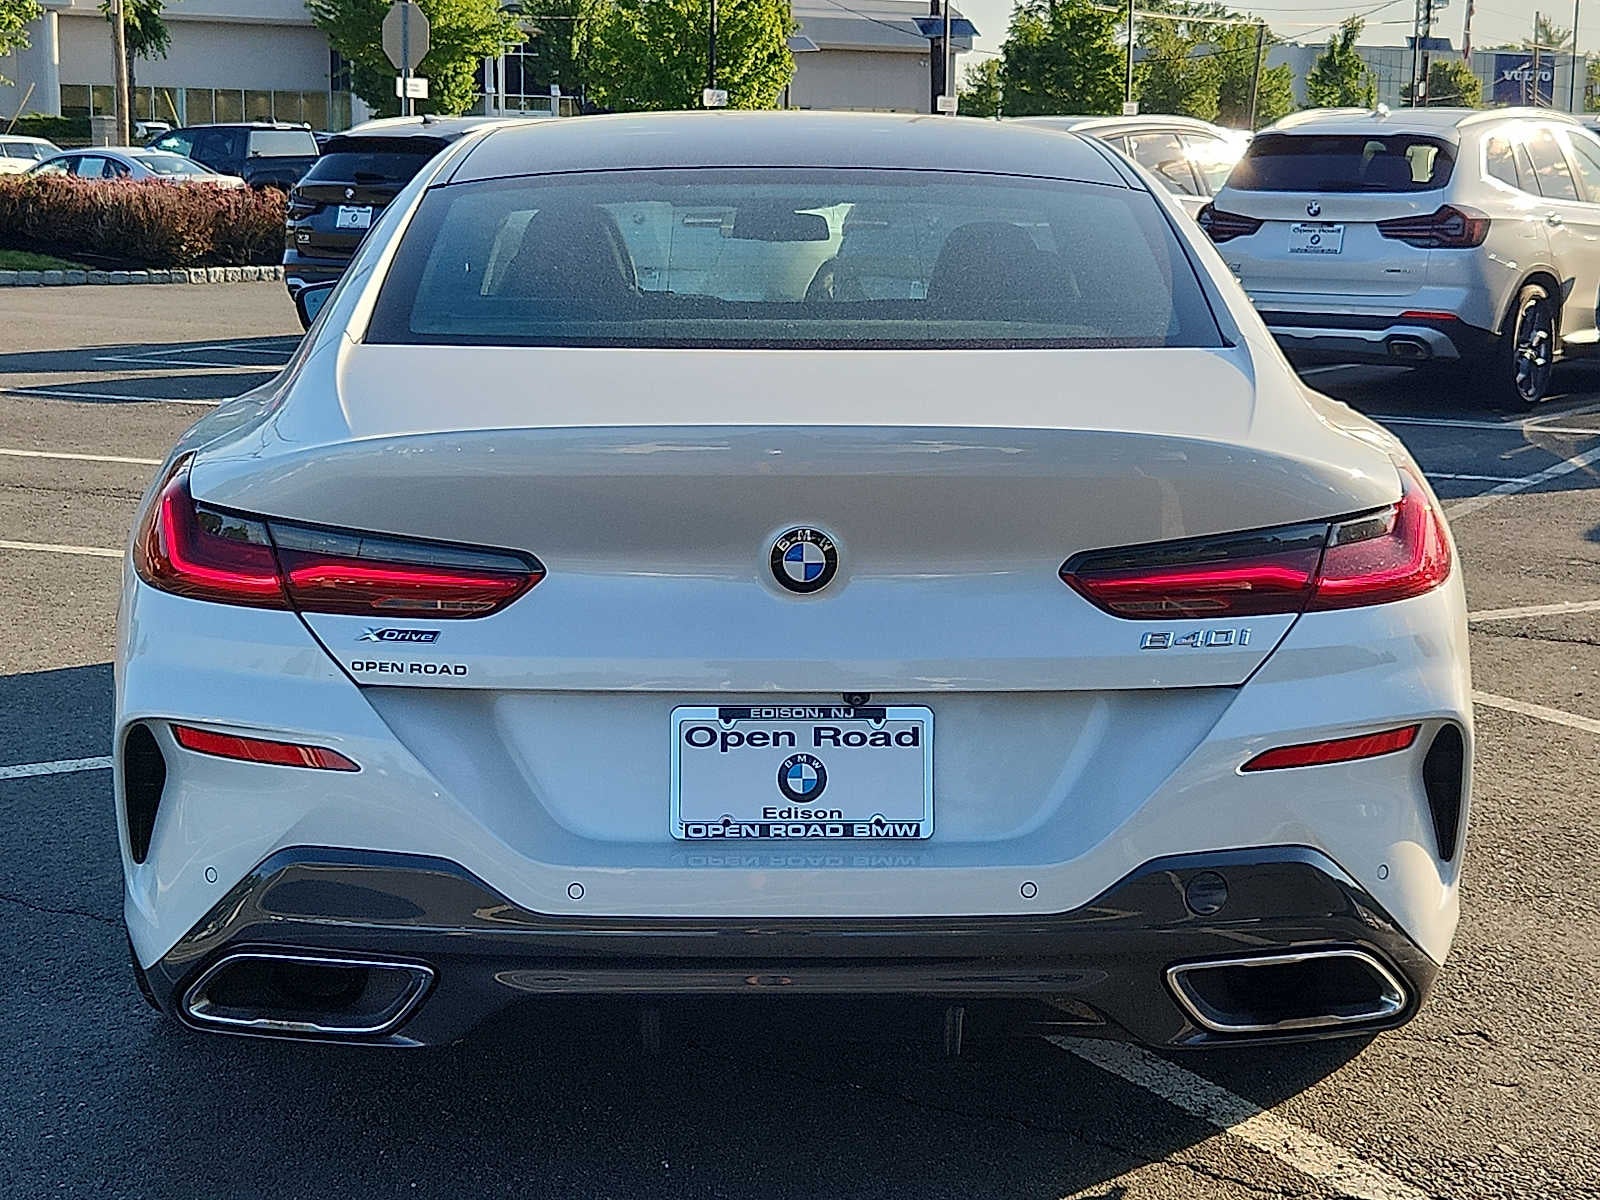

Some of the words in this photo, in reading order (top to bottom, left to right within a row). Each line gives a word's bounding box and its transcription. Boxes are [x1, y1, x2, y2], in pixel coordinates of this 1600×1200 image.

[351, 660, 405, 674] OPEN
[409, 662, 468, 676] ROAD
[750, 707, 824, 719] EDISON,
[830, 707, 855, 719] NJ
[684, 726, 796, 752] Open
[813, 726, 920, 747] Road
[762, 806, 843, 820] Edison
[687, 823, 760, 838] OPEN
[769, 823, 843, 838] ROAD
[853, 823, 918, 838] BMW
